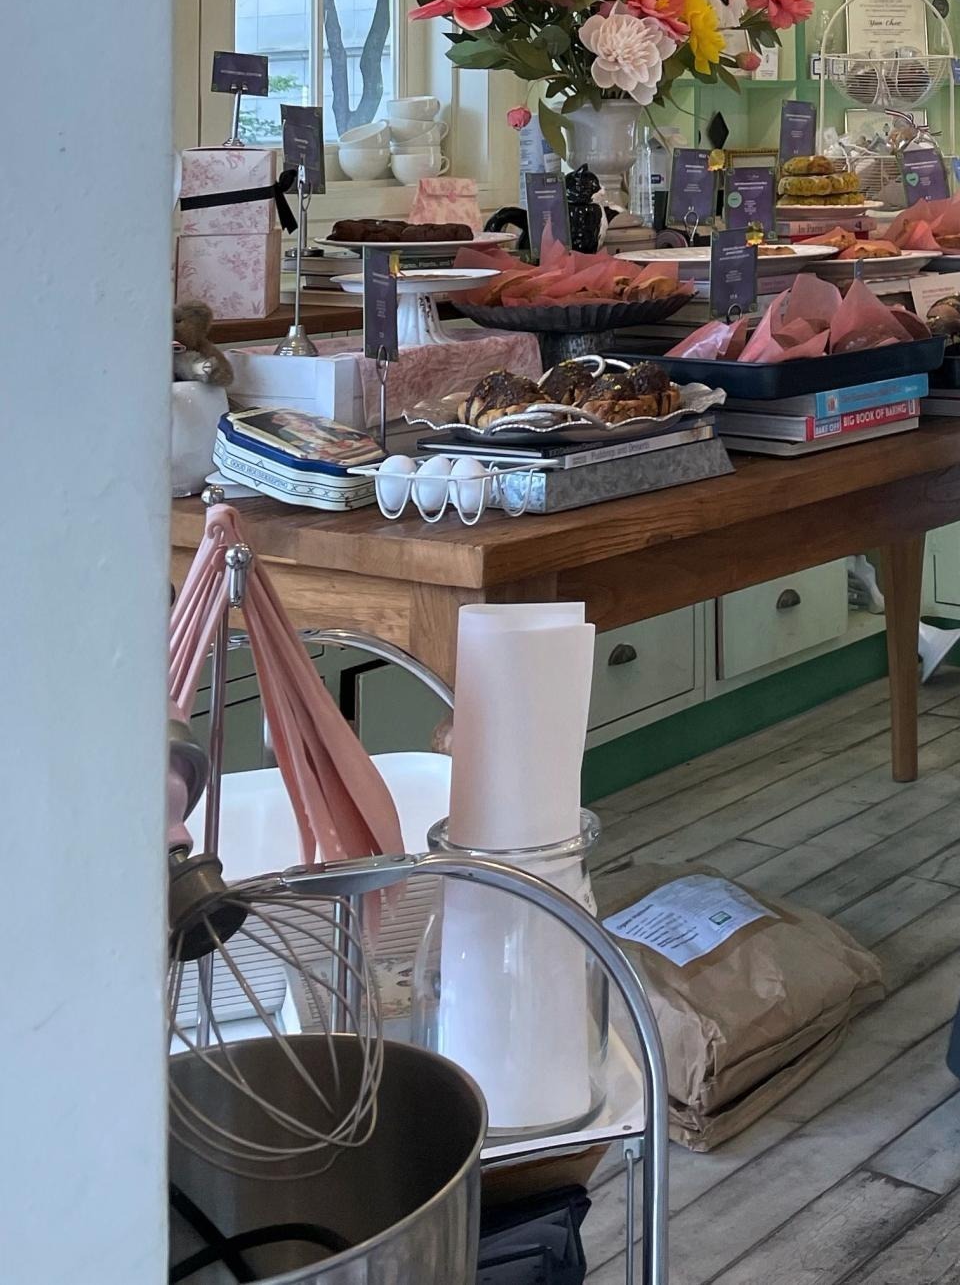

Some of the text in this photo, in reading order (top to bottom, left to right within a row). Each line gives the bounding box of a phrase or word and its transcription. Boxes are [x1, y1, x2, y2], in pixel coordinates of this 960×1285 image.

[843, 403, 907, 427] BIG BOOK OF BAKING
[230, 458, 247, 472] GOOD
